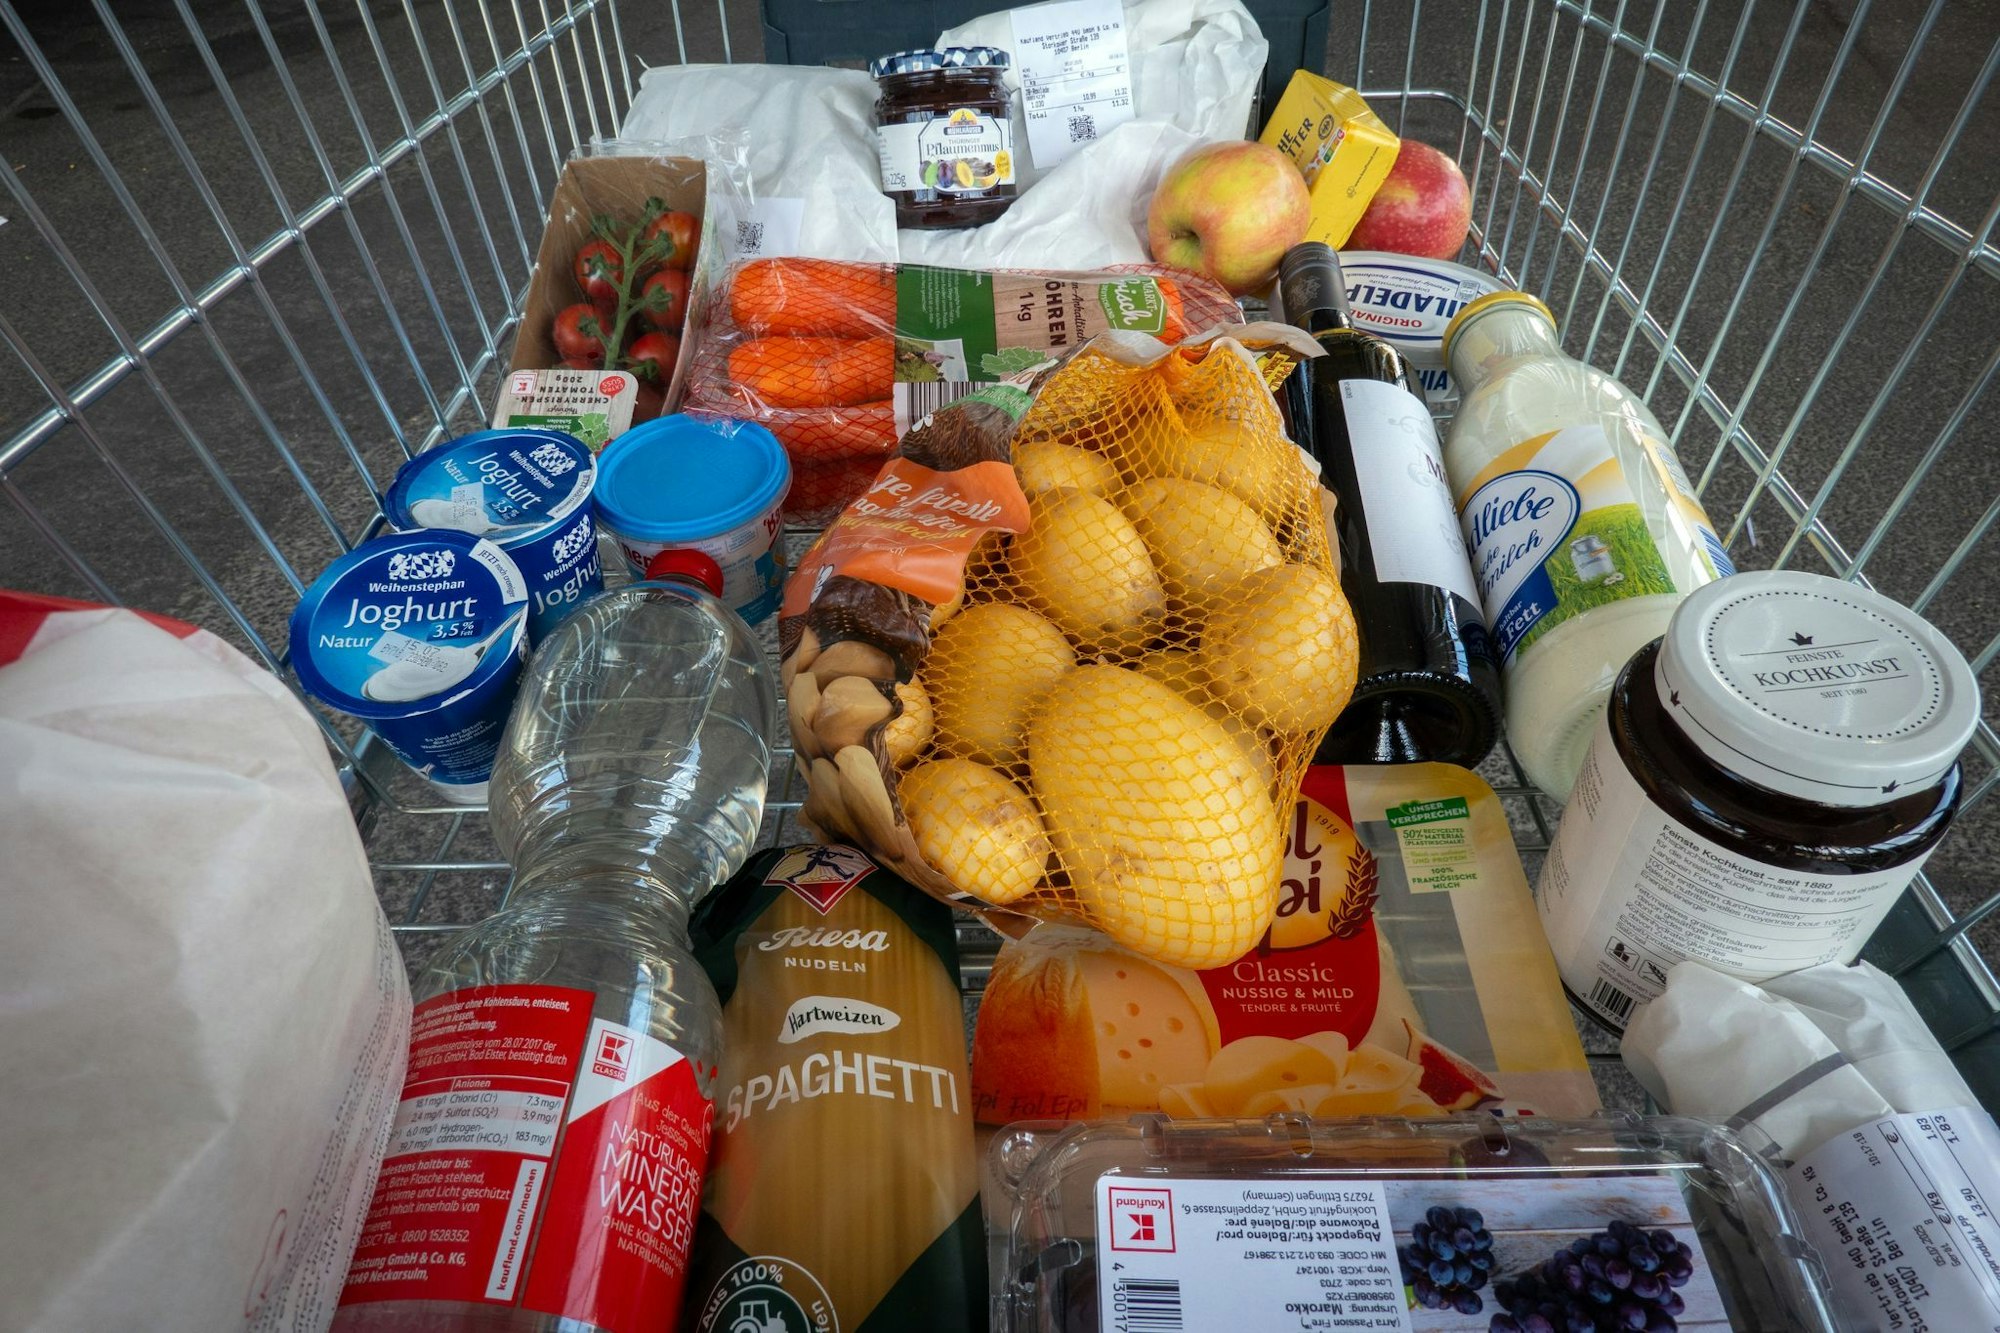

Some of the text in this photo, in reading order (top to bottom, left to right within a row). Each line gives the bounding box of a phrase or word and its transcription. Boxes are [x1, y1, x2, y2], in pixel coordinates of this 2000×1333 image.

[1071, 43, 1089, 52] Berlin
[1028, 98, 1129, 120] Total 11.32
[926, 142, 1000, 156] Pflaumenmus
[1017, 291, 1035, 322] 1 kg
[1045, 279, 1067, 346] ÖHREN
[555, 375, 583, 384] 200g
[540, 386, 594, 394] TOMATEN
[440, 458, 469, 484] Natur
[509, 449, 555, 489] Weihenstephan
[467, 452, 542, 510] Joghurt
[479, 548, 498, 565] JETZT
[368, 578, 466, 593] Weihenstephan
[343, 595, 478, 631] Joghurt
[1505, 601, 1542, 642] Fett
[318, 634, 374, 649] Natur
[1786, 650, 1844, 664] FEINSTE
[1752, 657, 1904, 687] KOCHKUNST
[1820, 689, 1843, 699] SEIT
[1408, 802, 1444, 813] UNSER
[1390, 806, 1467, 825] VERSPRECHEN
[1314, 813, 1340, 836] 1919
[1403, 829, 1424, 839] 50%
[1662, 824, 1833, 889] Feinste Kochkunst seit 1880
[1411, 873, 1478, 884] FRANZÖSISCHE
[1432, 882, 1460, 890] MILCH
[758, 925, 891, 952] Riesa
[784, 957, 867, 973] NUDELN
[1233, 961, 1336, 984] Classic
[1222, 987, 1355, 1000] NUSSIG & MILD
[532, 998, 571, 1012] enteisent,
[1240, 1001, 1343, 1014] TENDRE & FRUITÉ
[788, 1006, 885, 1036] Hartweizen
[501, 1036, 557, 1051] 28.07.2017 der
[544, 1053, 568, 1066] durch
[593, 1063, 625, 1081] CLASSIC
[455, 1078, 491, 1089] Anionen
[450, 1093, 480, 1104] Chlorid
[726, 1050, 960, 1136] SPAGHETTI
[444, 1106, 536, 1121] Sulfat 3,9
[635, 1091, 680, 1124] Aus der
[515, 1131, 530, 1142] 183
[655, 1118, 689, 1151] Jessen
[1884, 1130, 1900, 1144] €
[1933, 1114, 1961, 1145] 1.83
[417, 1157, 473, 1171] haltbar bis:
[610, 1120, 701, 1196] NATÜRLICHES
[1915, 1116, 1988, 1220] 13.90 1.83
[410, 1171, 485, 1185] Flasche stehend,
[602, 1142, 695, 1229] MINERAL
[417, 1186, 512, 1200] und Licht geschützt
[1242, 1189, 1375, 1203] 76275 Ettlingen (Germany)
[1851, 1131, 1947, 1268] 05.07.2025 10:17:18
[461, 1202, 480, 1212] von
[1115, 1197, 1165, 1210] Kaufland
[1181, 1203, 1378, 1217] Looking4fruit GmbH, Zeppelinstrasse 6,
[600, 1174, 692, 1259] WASSER
[1224, 1216, 1380, 1230] Pakowane dla:/Balené pre:
[496, 1167, 538, 1292] kaufland.com/machen
[601, 1215, 635, 1237] OHNE
[401, 1230, 427, 1243] 0800
[1215, 1229, 1382, 1243] Abgepackt für:/Baleno pro:/
[1243, 1249, 1387, 1260] MH CODE: 093.012.213.298167
[1801, 1165, 1903, 1330] Vertrieb 440 GmbH & Co. KG
[387, 1251, 468, 1267] GmbH & Co. KG,
[617, 1237, 675, 1279] NATRIUMARM
[1871, 1216, 1931, 1301] 10407 Berlin
[1110, 1261, 1125, 1273] 4
[1295, 1265, 1335, 1275] 1001247
[1837, 1201, 1930, 1333] Storkower Straße 139
[369, 1267, 430, 1283] Neckarsulm,
[730, 1263, 784, 1288] 100%
[1320, 1278, 1393, 1288] Los code: 2703
[1325, 1291, 1396, 1301] 095808/EPX25
[1285, 1302, 1399, 1315] Ursprung: Marokko
[1333, 1316, 1402, 1329] (Arra Passion
